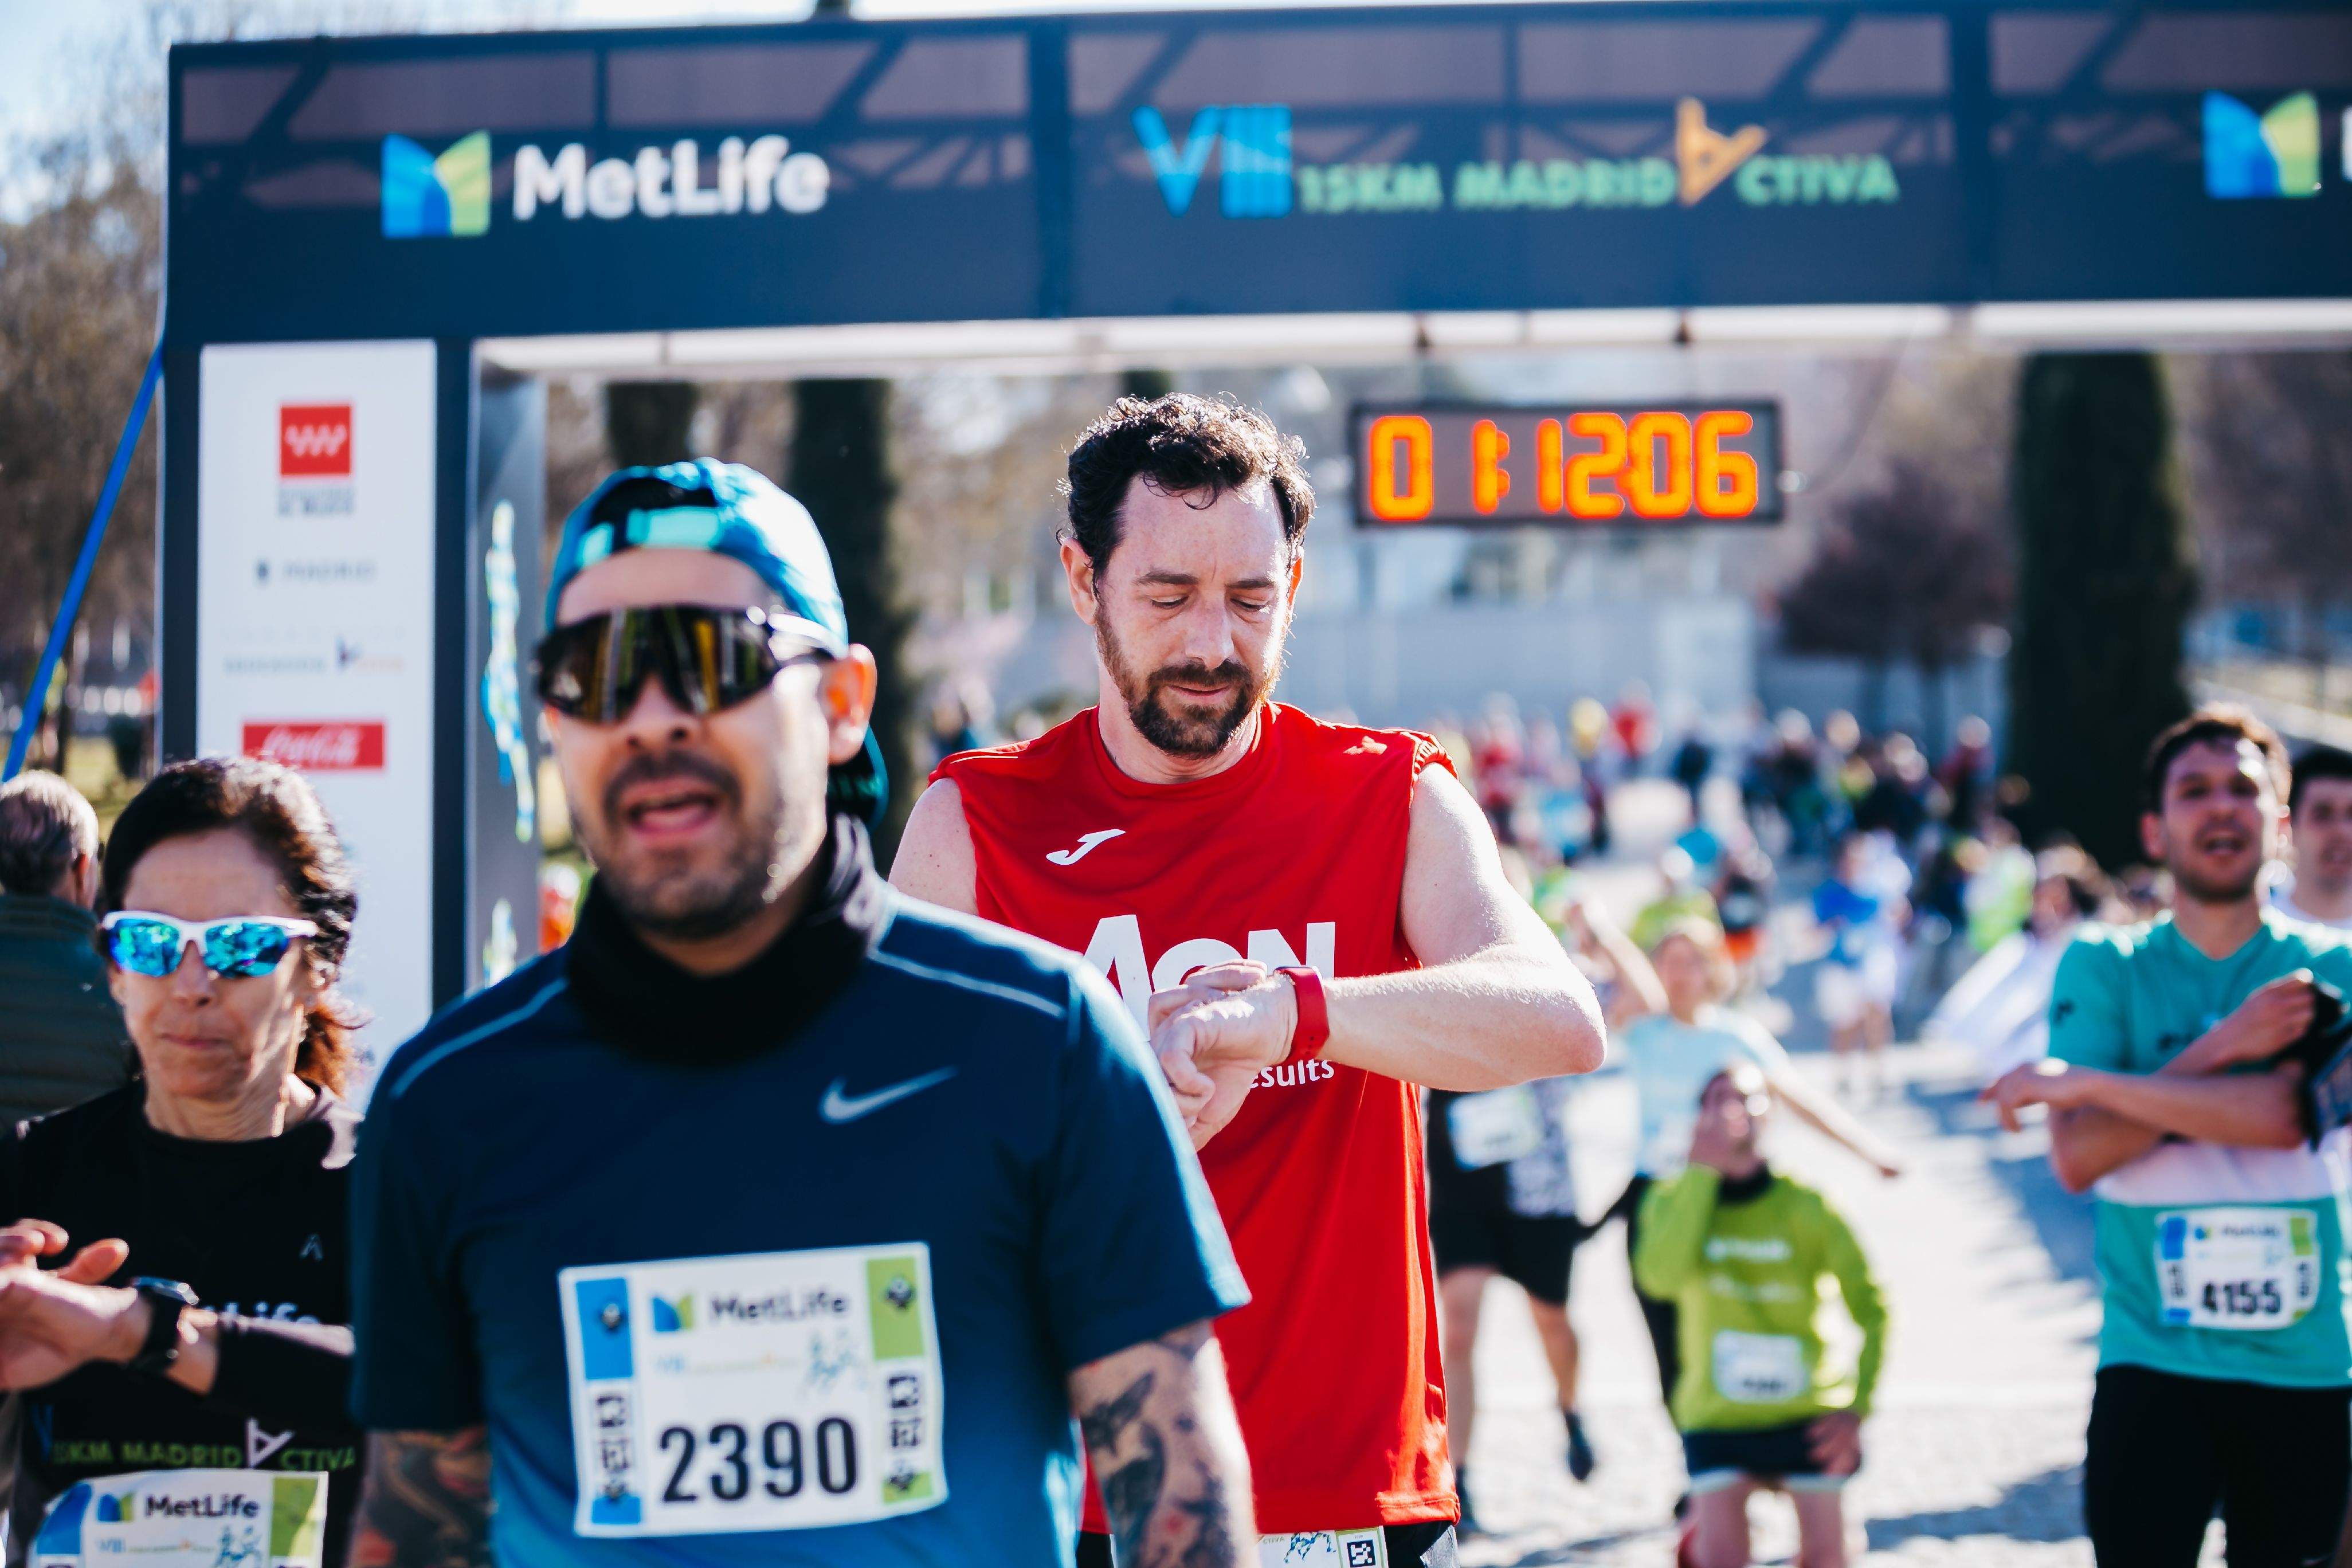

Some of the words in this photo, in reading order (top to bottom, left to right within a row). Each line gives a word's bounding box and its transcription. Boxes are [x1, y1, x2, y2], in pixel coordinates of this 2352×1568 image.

[512, 133, 832, 221] MetLife
[1129, 103, 1293, 218] VIII
[1300, 162, 1443, 213] 15KM
[1453, 158, 1676, 210] MADRID
[1249, 1058, 1335, 1088] sults
[2202, 1279, 2283, 1315] 4155
[120, 1440, 242, 1468] MADRID
[659, 1417, 860, 1504] 2390
[144, 1492, 260, 1520] MetLife
[1259, 1534, 1285, 1545] CTIVA
